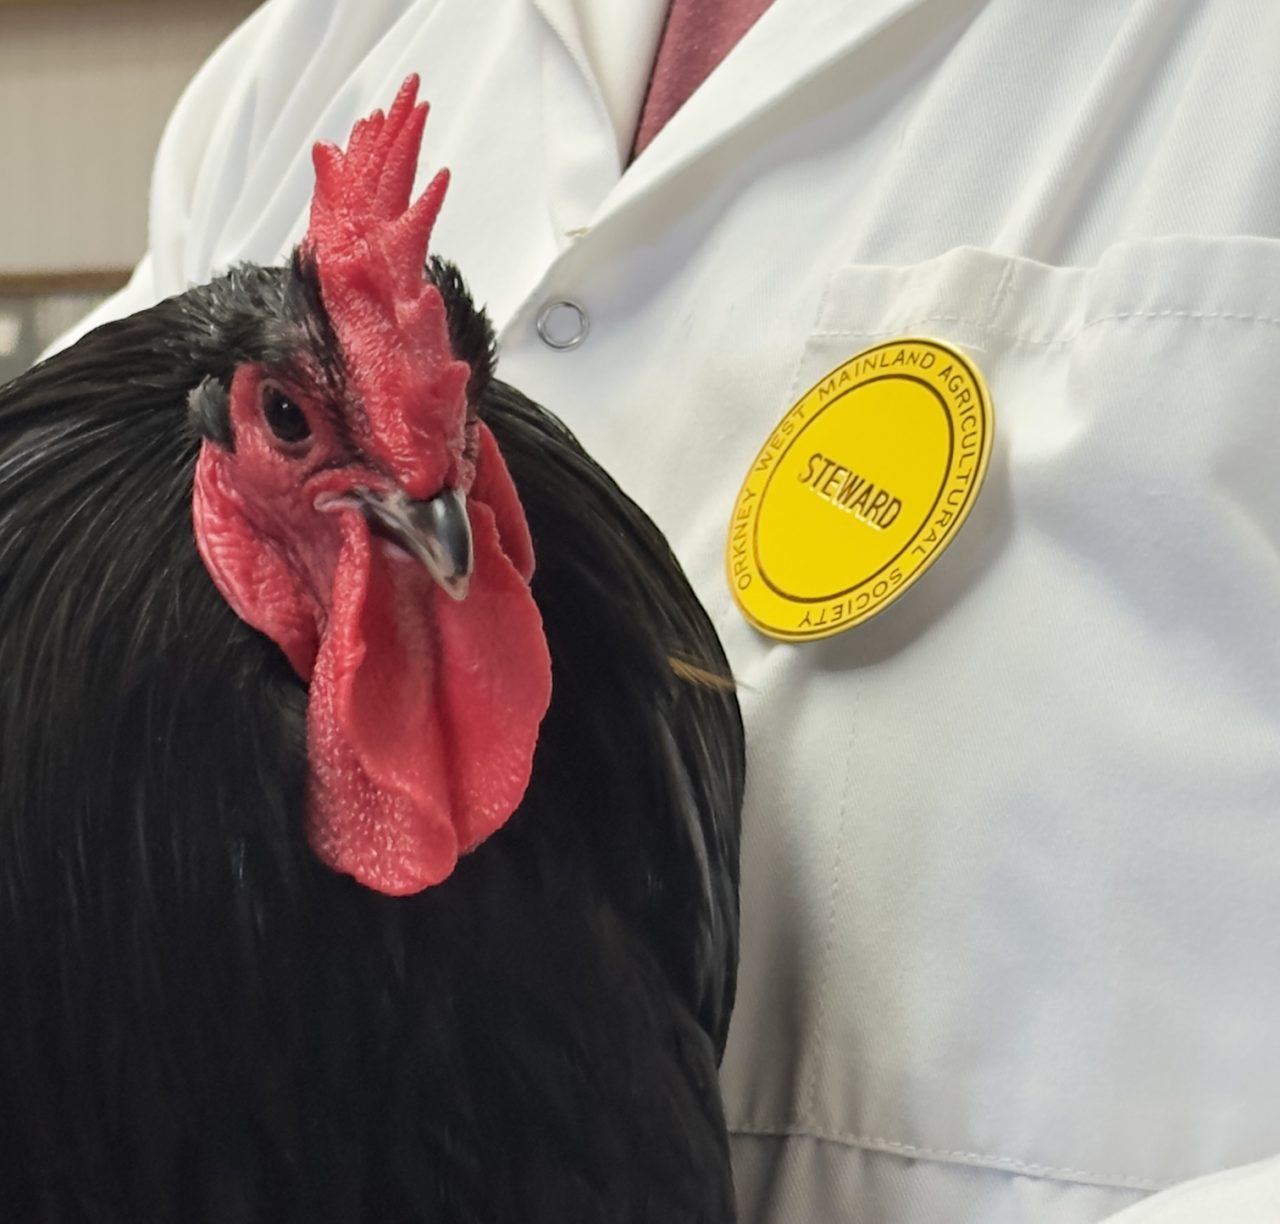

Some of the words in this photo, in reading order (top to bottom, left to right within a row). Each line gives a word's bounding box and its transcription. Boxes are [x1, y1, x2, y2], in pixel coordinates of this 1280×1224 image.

[817, 349, 936, 402] MAINLAND
[756, 404, 807, 473] WEST
[911, 365, 977, 557] AGRICULTURAL
[797, 452, 903, 530] STEWARD
[733, 489, 757, 590] ORKNEY
[798, 567, 903, 628] SOCIETY
